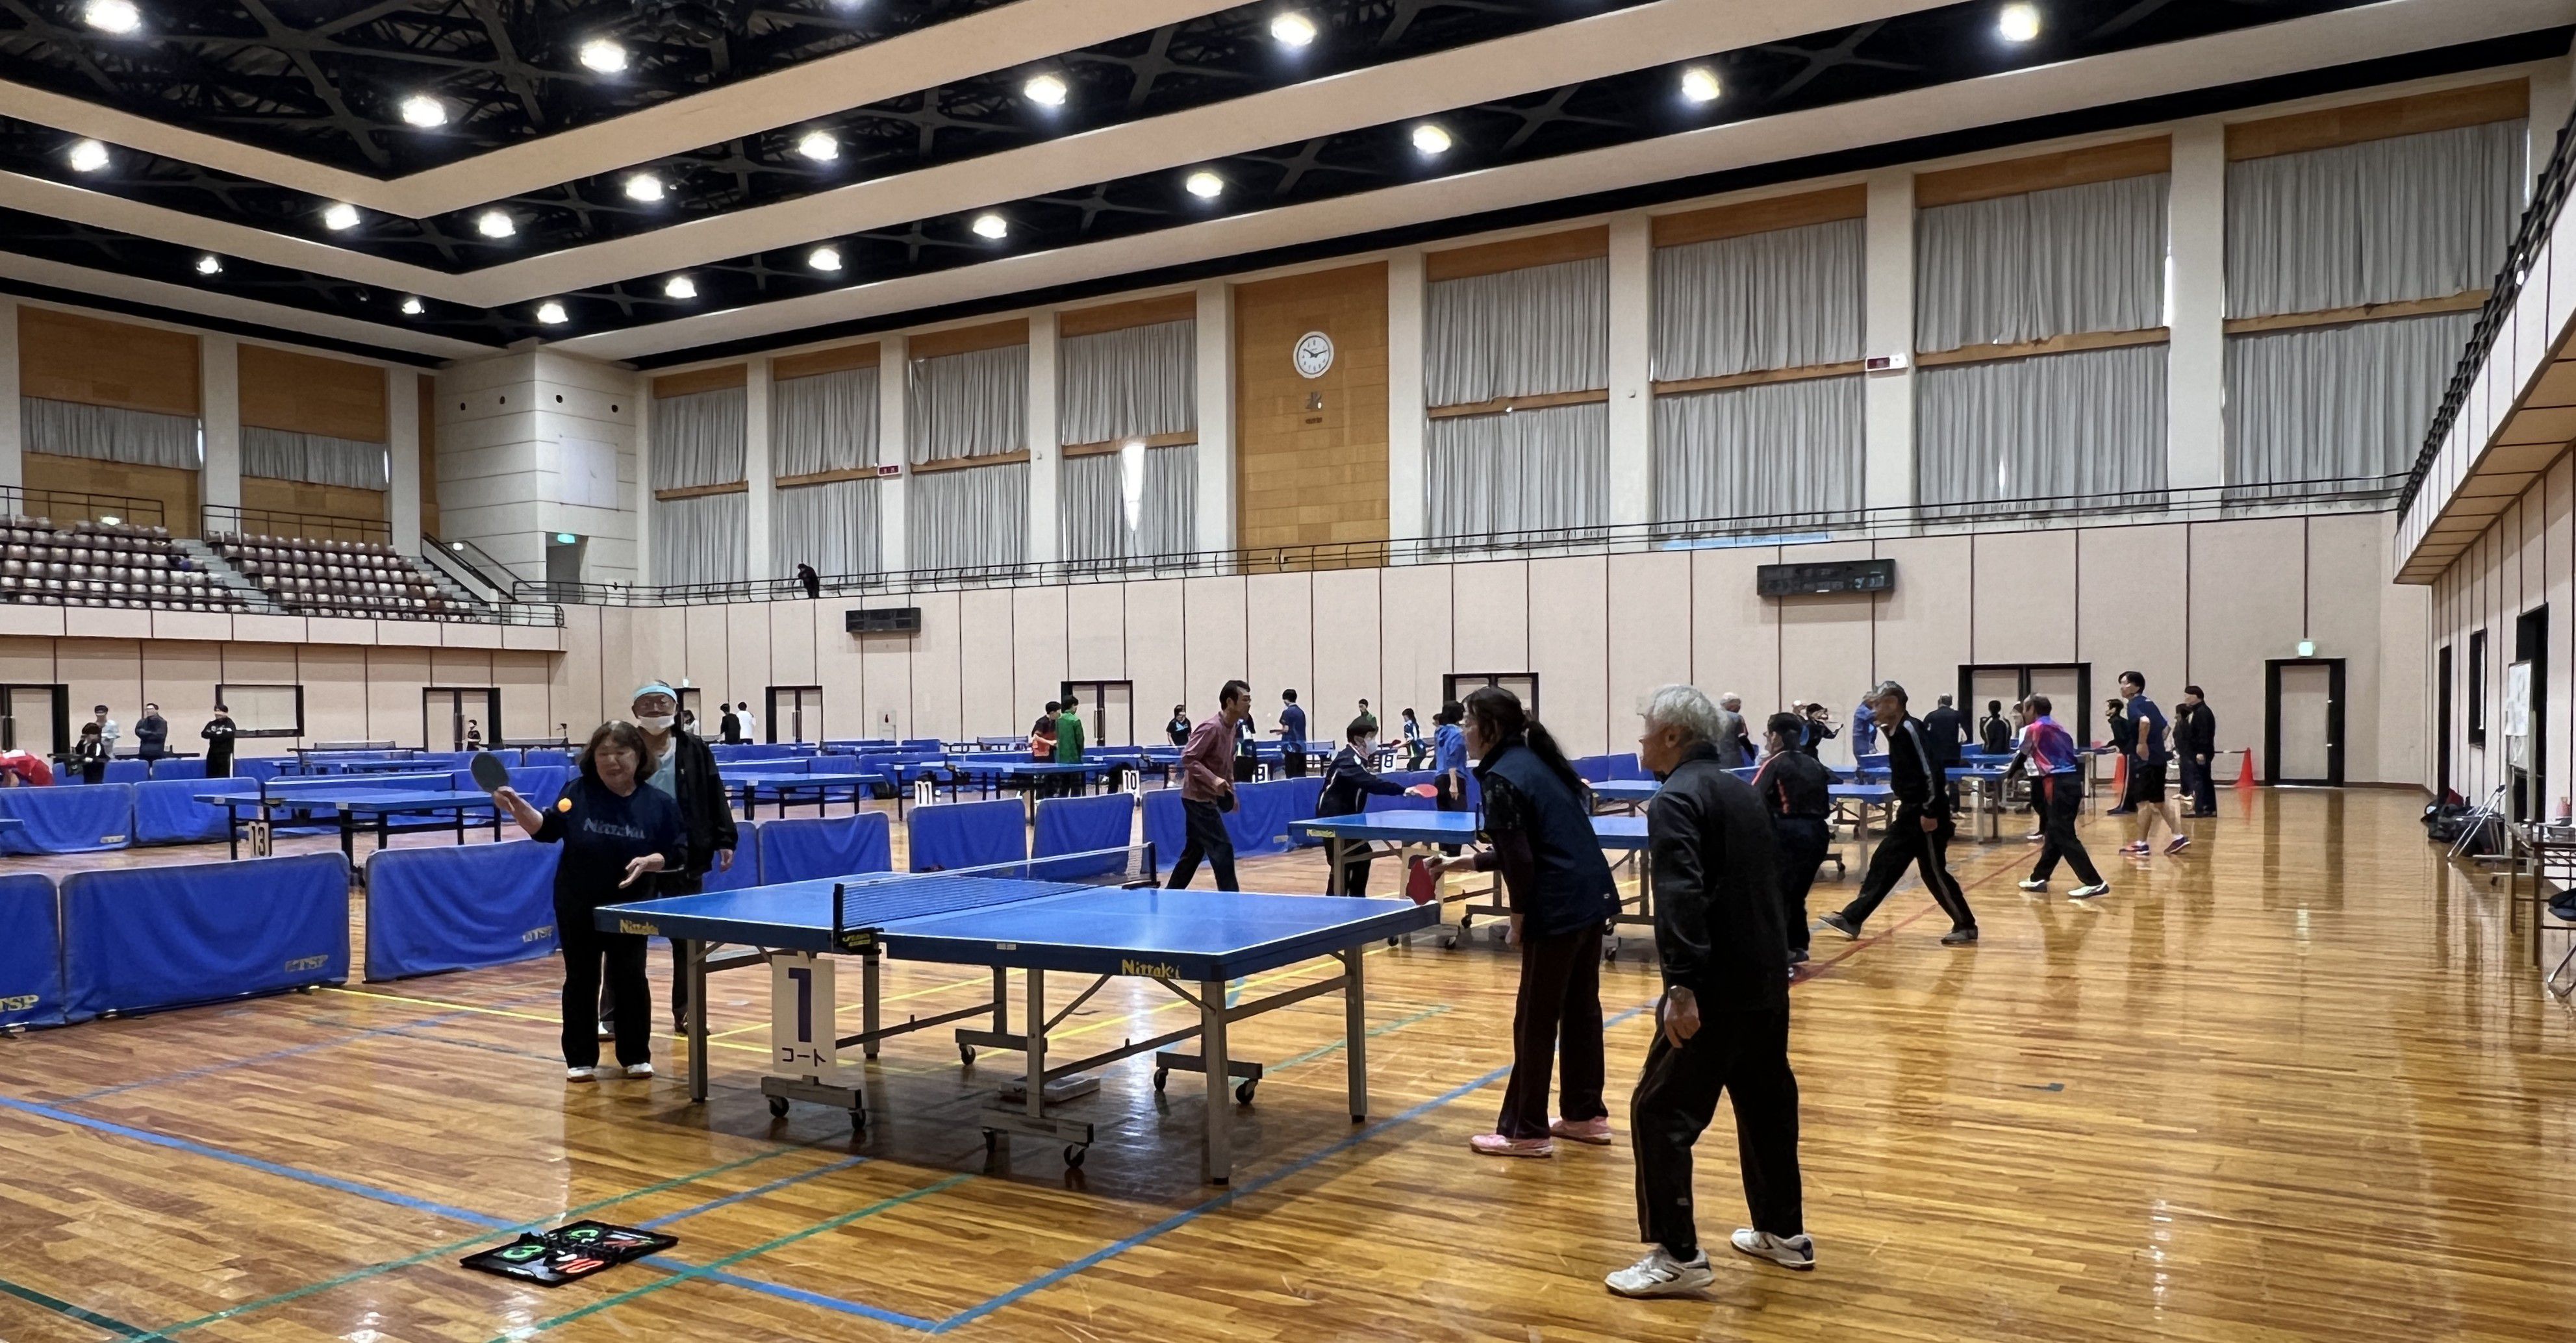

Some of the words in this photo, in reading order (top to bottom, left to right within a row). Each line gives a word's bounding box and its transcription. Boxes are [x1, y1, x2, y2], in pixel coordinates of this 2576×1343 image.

[1384, 755, 1393, 768] 8
[1125, 772, 1137, 790] 10
[918, 784, 929, 804] 11
[251, 826, 266, 856] 13
[788, 967, 811, 1043] 1
[781, 1047, 826, 1067] コート
